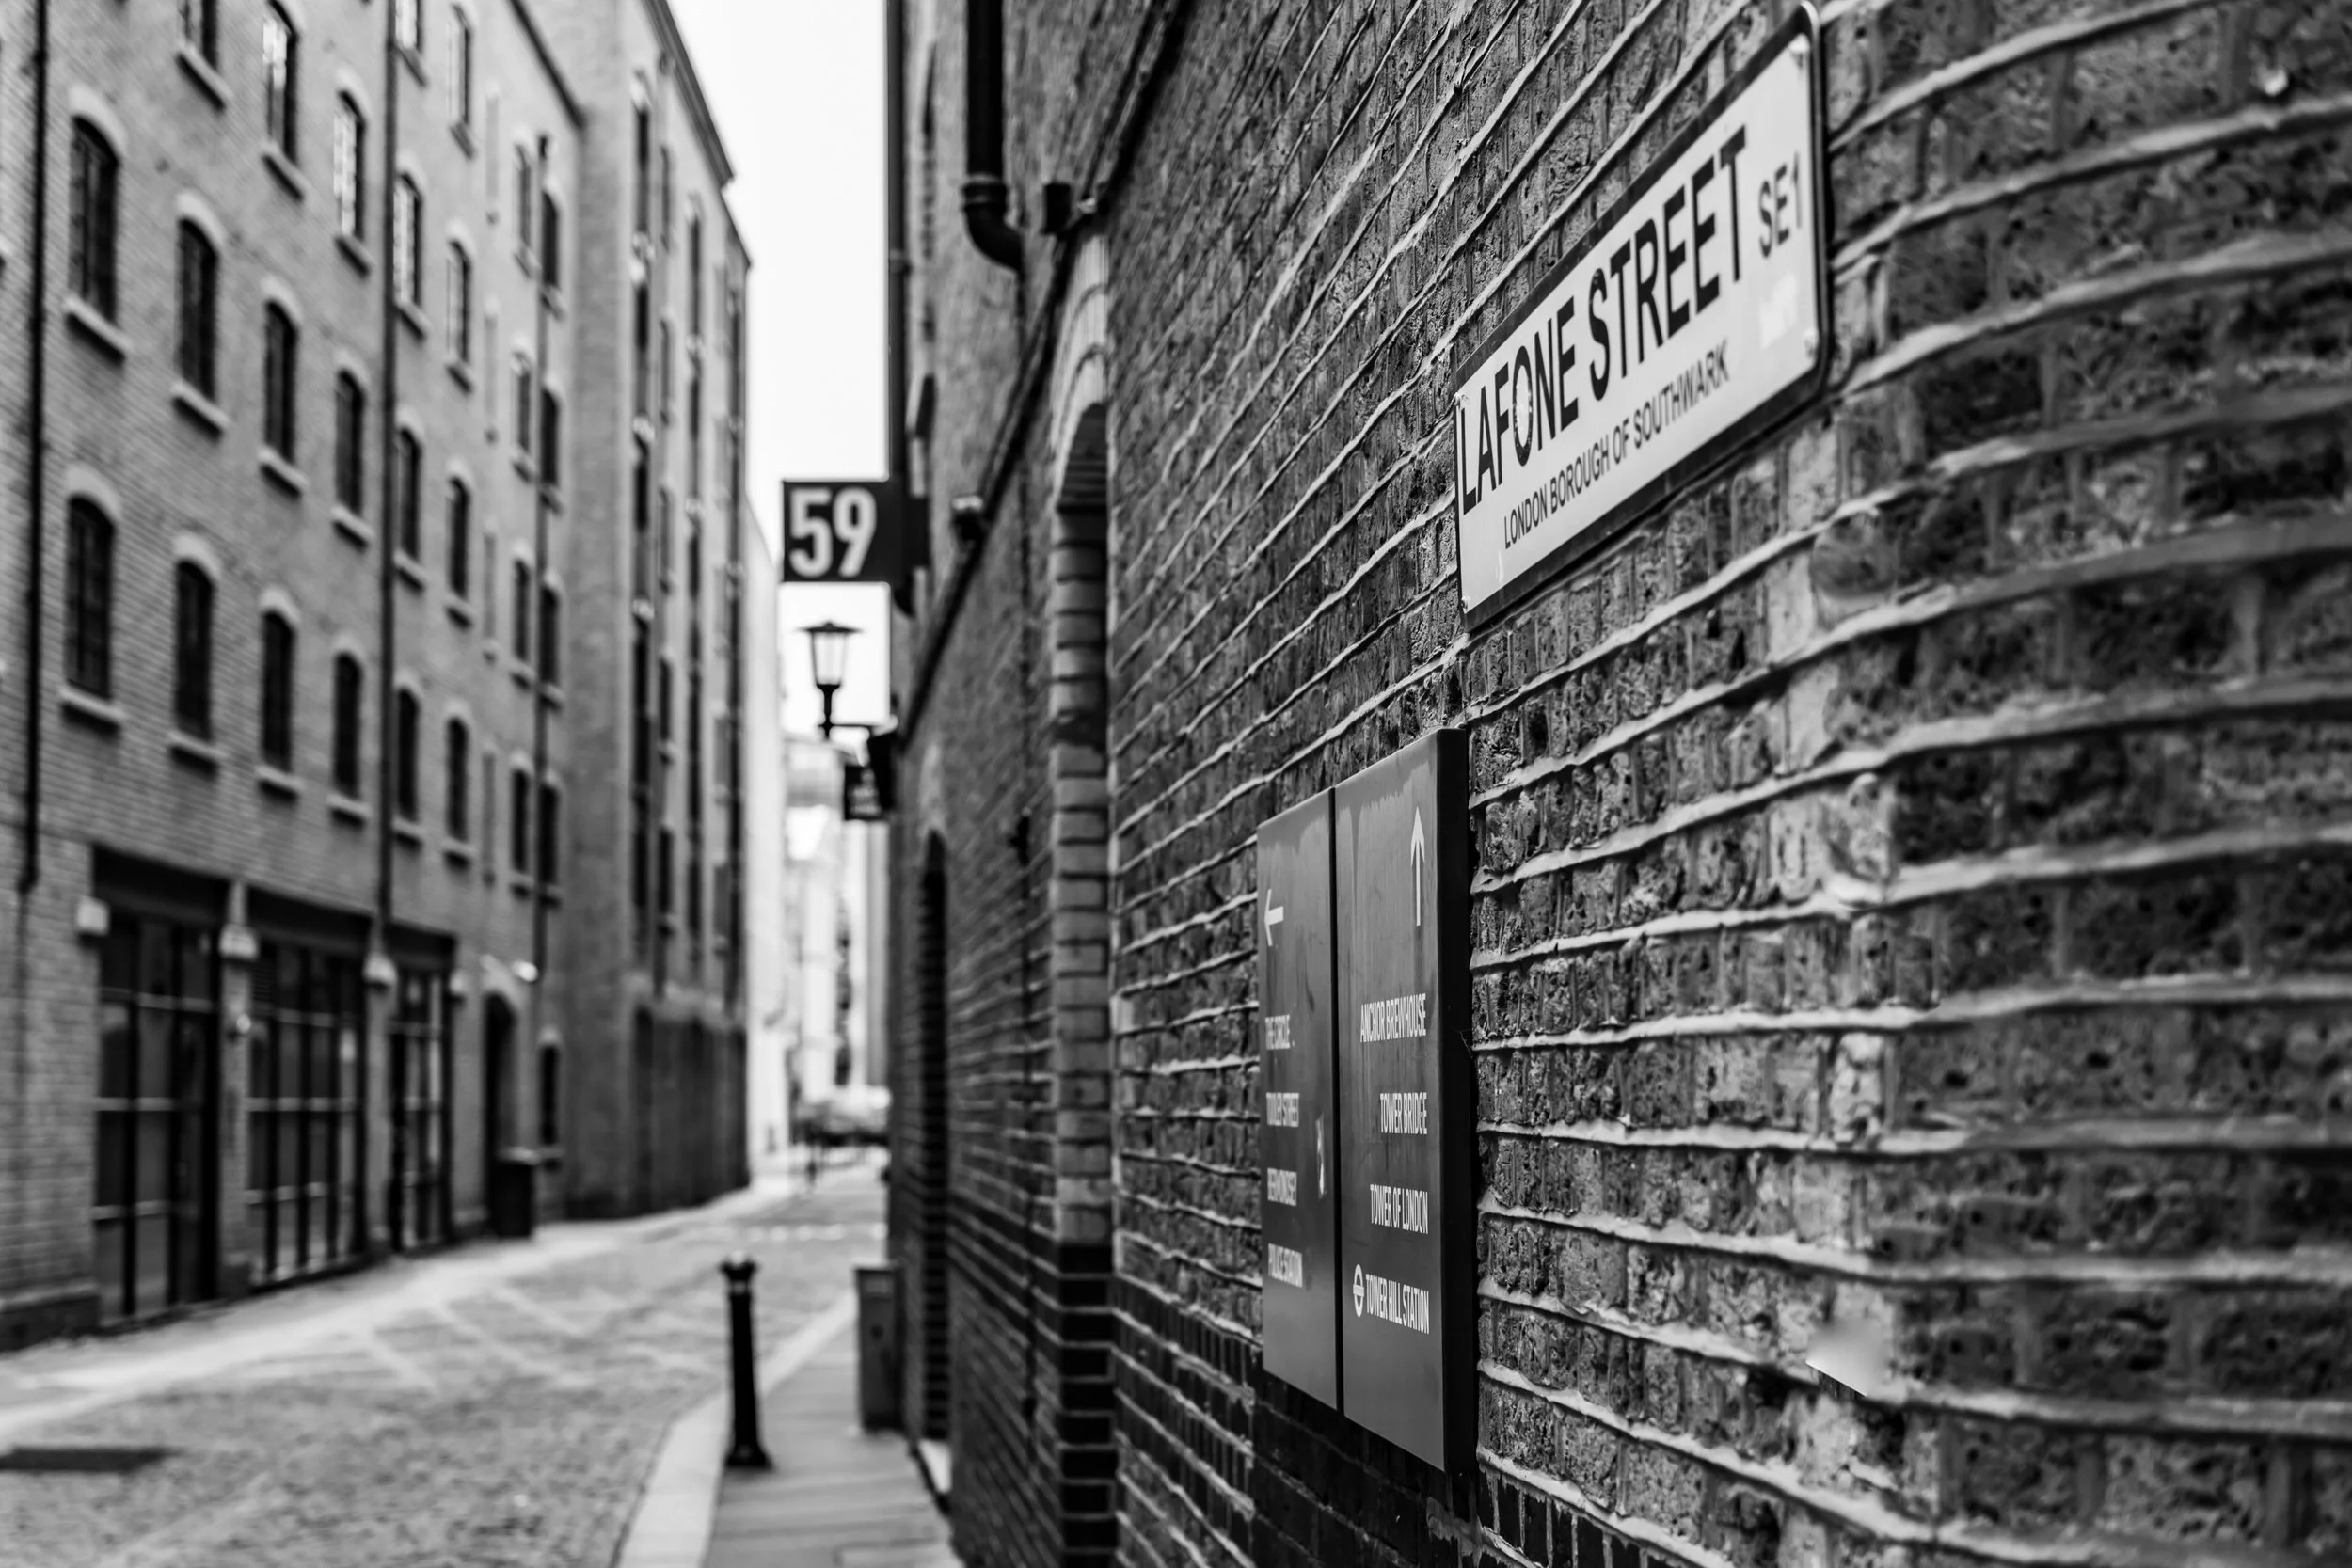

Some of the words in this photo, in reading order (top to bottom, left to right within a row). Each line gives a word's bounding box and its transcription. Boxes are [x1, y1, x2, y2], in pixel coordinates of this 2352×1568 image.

[1460, 296, 1579, 515] LAFONE
[1588, 123, 1746, 401] STREET
[1757, 151, 1802, 259] SE1
[1504, 483, 1548, 549] LONDON
[1549, 434, 1610, 515] BOROUGH
[1612, 417, 1629, 463] OF
[1633, 338, 1729, 450] SOUTHWARK
[788, 485, 877, 578] 59
[1360, 1000, 1385, 1043] ANCHOR
[1386, 993, 1426, 1040] BREWHOUSE
[1379, 1092, 1403, 1133] TOWER
[1403, 1092, 1427, 1134] BRIDGE
[1370, 1183, 1392, 1227] TOWER
[1392, 1186, 1401, 1228] OF
[1402, 1188, 1428, 1234] LONDON
[1365, 1273, 1388, 1320] TOWER
[1388, 1279, 1402, 1324] HILL
[1402, 1284, 1429, 1334] STATION
